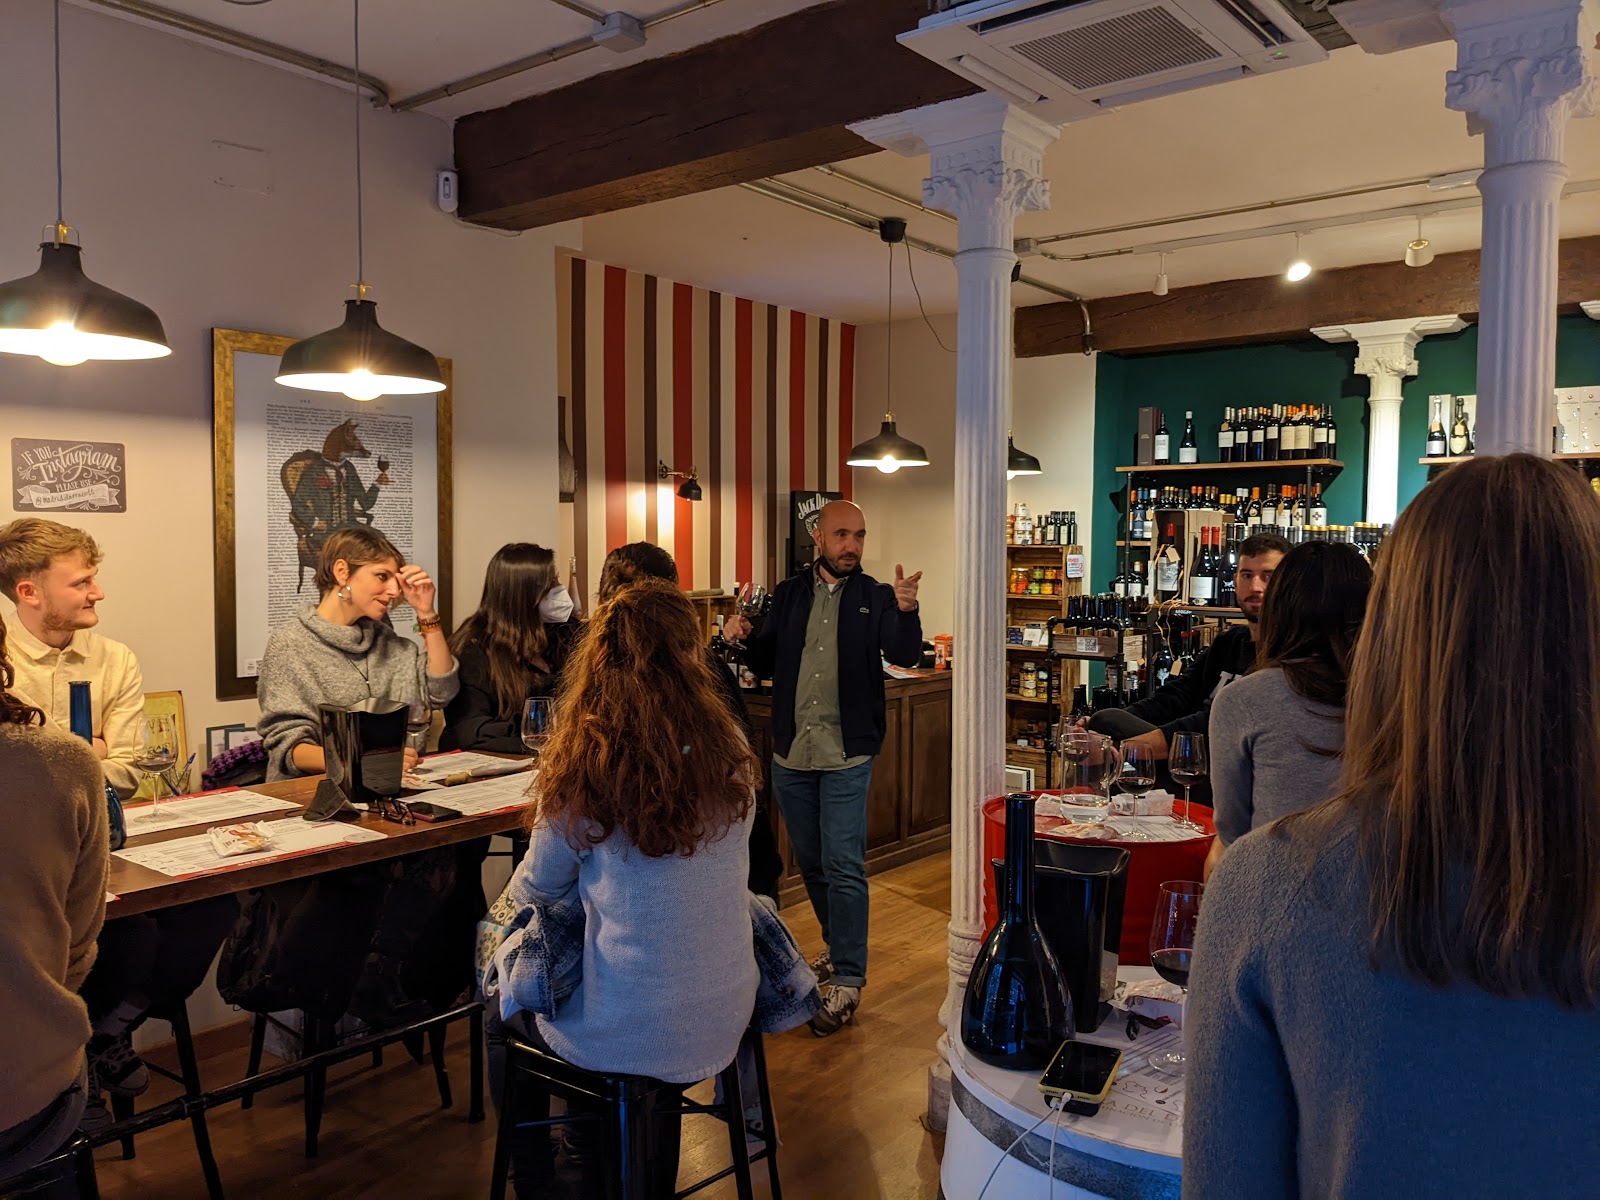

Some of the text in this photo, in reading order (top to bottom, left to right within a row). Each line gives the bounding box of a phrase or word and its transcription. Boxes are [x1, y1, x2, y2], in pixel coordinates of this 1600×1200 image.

[21, 445, 53, 465] IF YOU
[32, 444, 122, 486] Instagram
[55, 479, 93, 493] PLEASE USE
[797, 497, 816, 520] JACK
